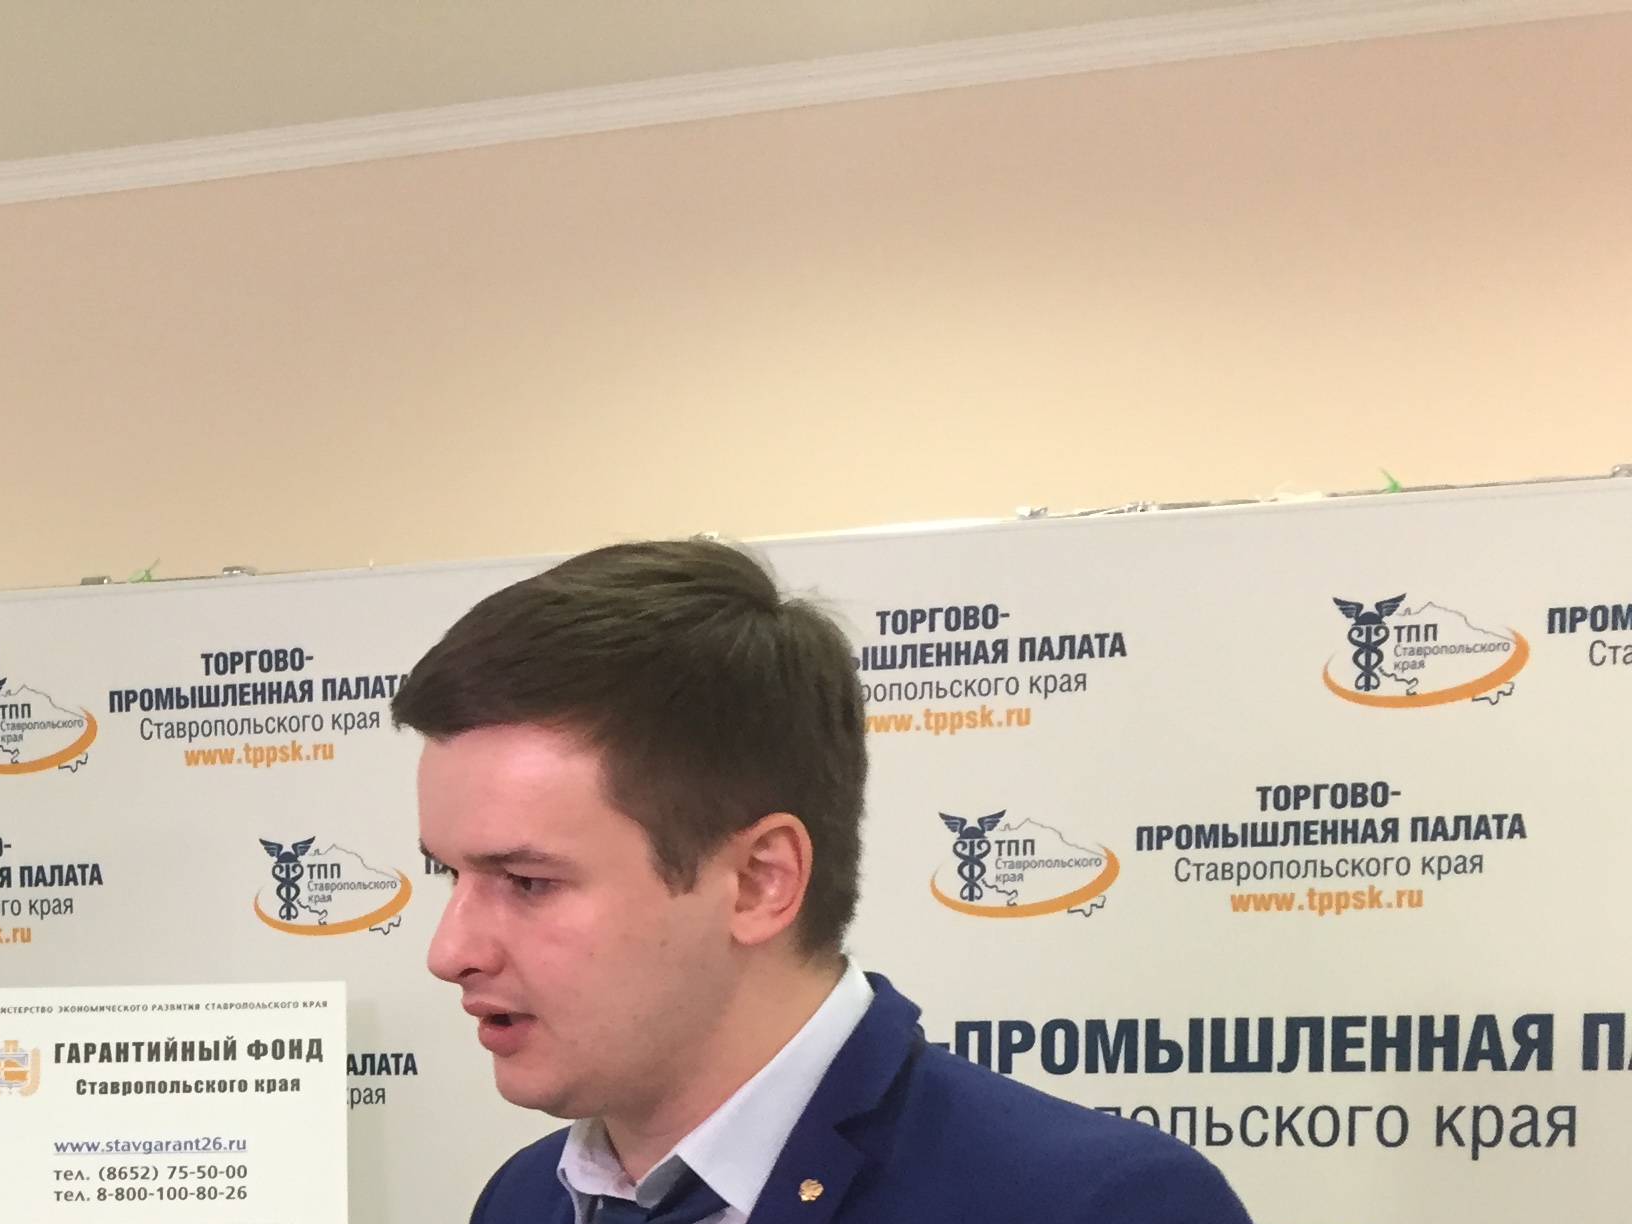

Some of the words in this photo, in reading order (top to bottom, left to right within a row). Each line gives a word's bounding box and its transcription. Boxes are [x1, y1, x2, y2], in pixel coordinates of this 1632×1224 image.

[876, 604, 1010, 635] ТОРГОВО-
[1394, 624, 1438, 643] ТПП
[1019, 633, 1126, 662] ПАЛАТА
[201, 648, 314, 676] ТОРГОВО-
[109, 680, 313, 714] ПРОМЫШЛЕННАЯ
[1029, 672, 1087, 700] края
[0, 702, 31, 720] ТПП
[140, 713, 324, 743] Ставропольского
[331, 708, 381, 734] края
[184, 739, 334, 768] www.tppsk.ru
[1256, 783, 1401, 811] ТОРГОВО-
[1136, 817, 1399, 850] ПРОМЫШЛЕННАЯ
[1410, 814, 1527, 841] ПАЛАТА
[995, 838, 1035, 856] ТПП
[19, 864, 103, 887] ПАЛАТА
[307, 862, 341, 879] ТПП
[1174, 854, 1411, 883] Ставропольского
[1421, 852, 1484, 878] края
[28, 895, 74, 918] края
[1230, 886, 1423, 915] www.tppsk.ru
[57, 1004, 149, 1014] ЭКОНОМИЧЕСКОГО
[151, 1002, 201, 1012] РАЗВИТИЯ
[204, 1001, 299, 1011] СТАВРОПОЛЬСКОГО
[302, 1000, 329, 1009] КРАЯ
[54, 1036, 237, 1064] ГАРАНТИЙНЫЙ
[247, 1037, 324, 1063] ФОНД
[75, 1078, 248, 1097] Ставропольского
[254, 1076, 301, 1094] края
[347, 1086, 386, 1109] рая
[54, 1136, 247, 1155] www.stavgarant26.ru
[1433, 1104, 1577, 1160] края
[54, 1168, 91, 1182] тел.
[98, 1165, 159, 1183] (8652)
[167, 1164, 248, 1180] 75-50-00
[54, 1188, 91, 1202] тел.
[96, 1185, 248, 1202] 8-800-100-80-26
